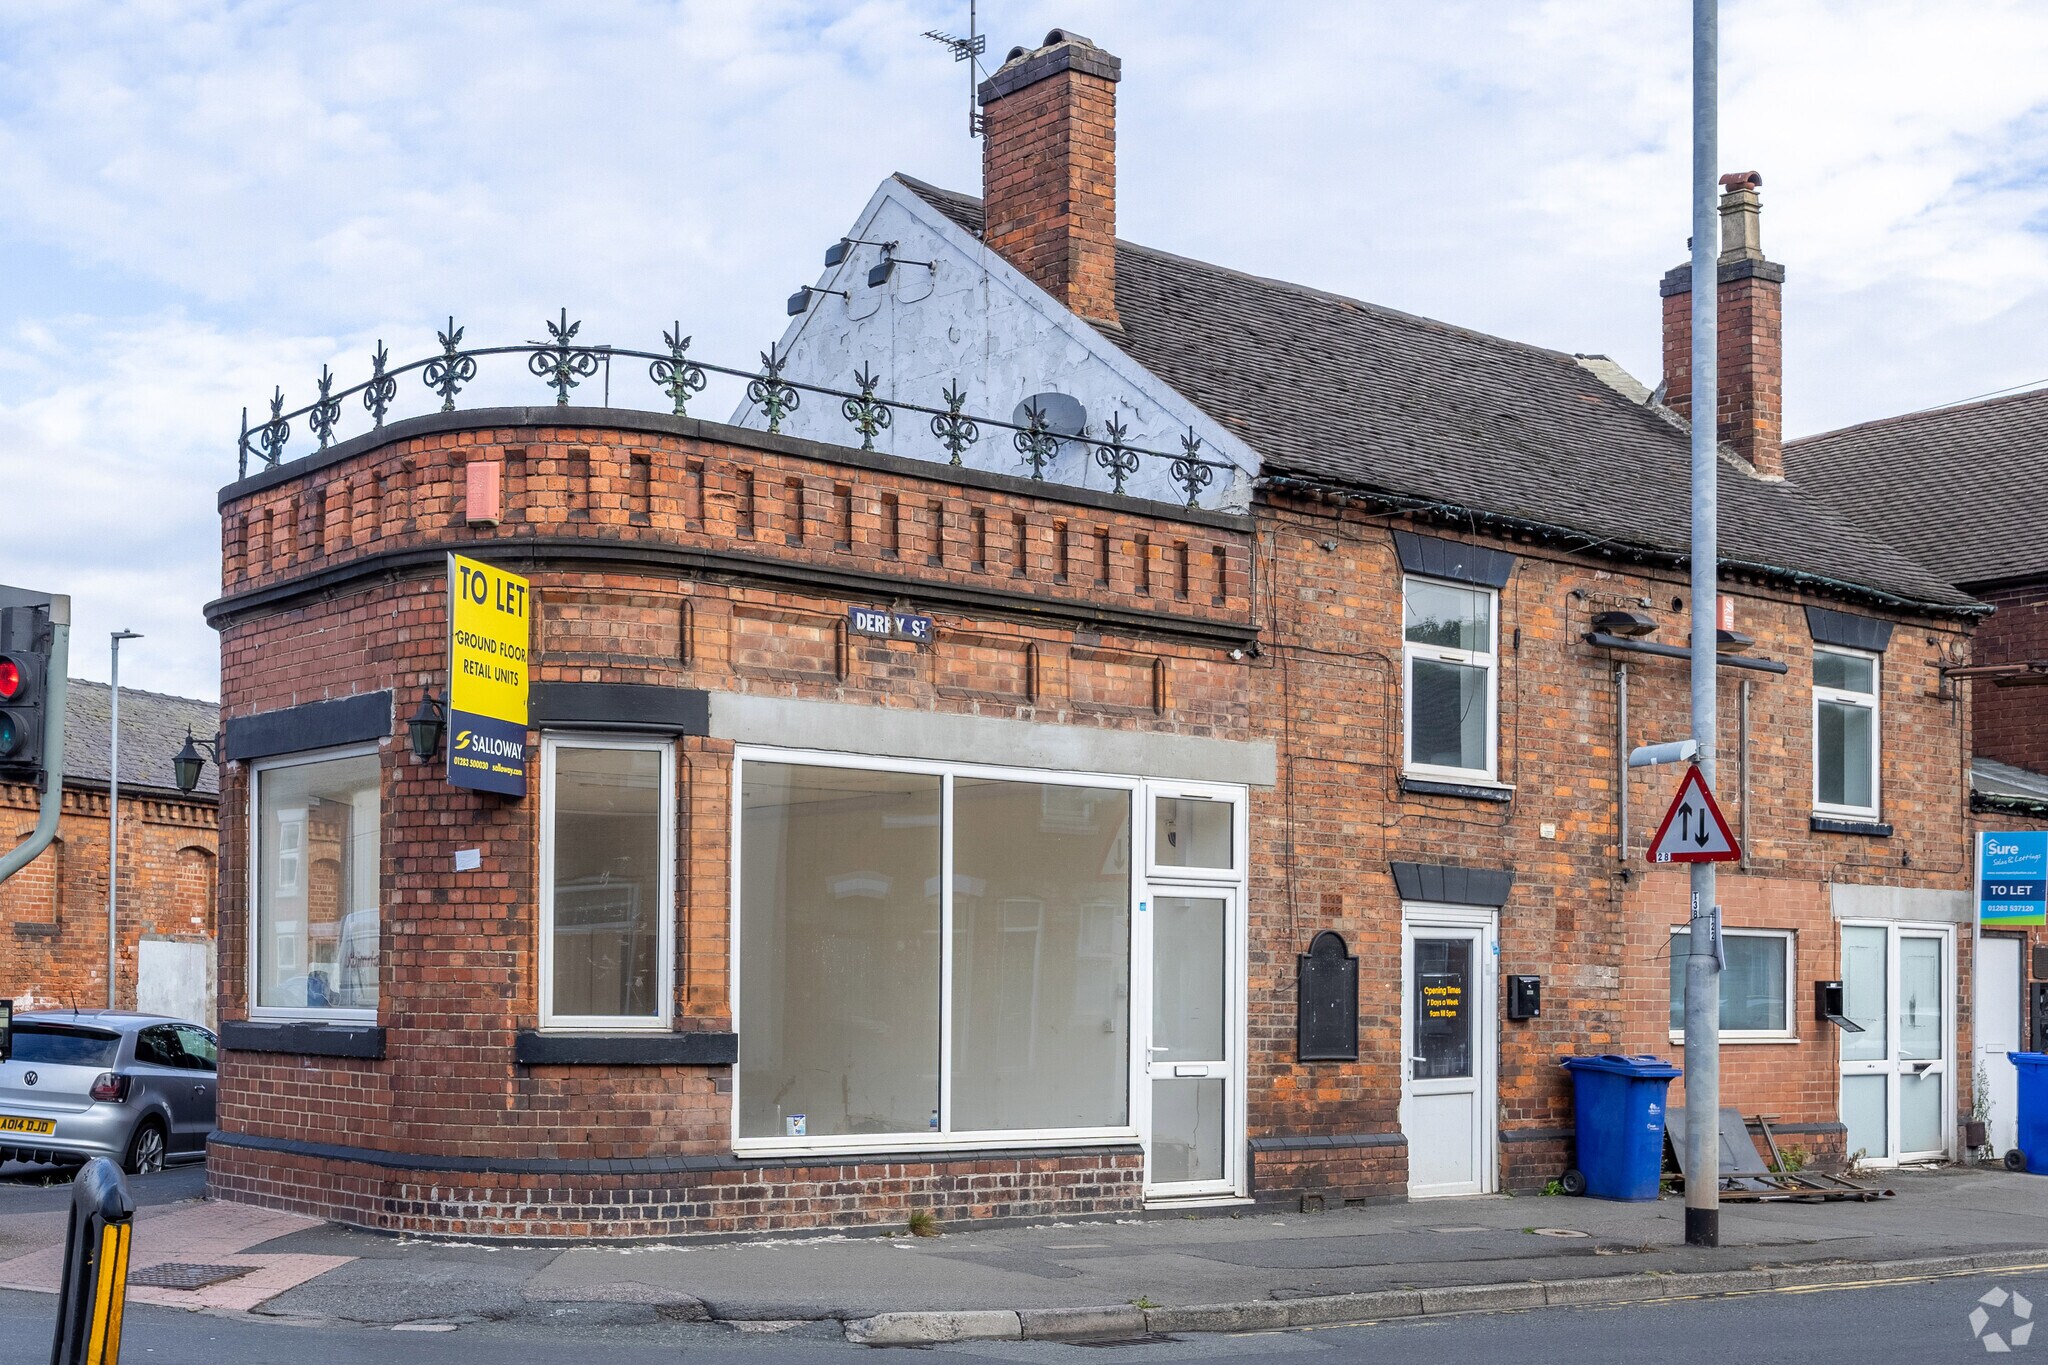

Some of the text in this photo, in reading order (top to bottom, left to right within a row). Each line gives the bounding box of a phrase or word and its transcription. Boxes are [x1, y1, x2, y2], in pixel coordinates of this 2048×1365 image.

[459, 565, 525, 618] TO LET
[456, 630, 526, 663] GROUND FLOOR
[463, 658, 519, 687] RETAIL UNITS
[471, 734, 523, 760] SALLOWAY
[453, 756, 469, 767] 01283
[492, 763, 523, 776] salloway.com
[1988, 843, 2019, 855] Sure
[1658, 853, 1669, 861] 28
[1992, 853, 2041, 866] Sales & Lettings
[1990, 885, 2033, 896] TO LET
[1424, 986, 1461, 996] Opening Times
[1430, 999, 1441, 1007] Days
[0, 1119, 49, 1133] AO14 DJD
